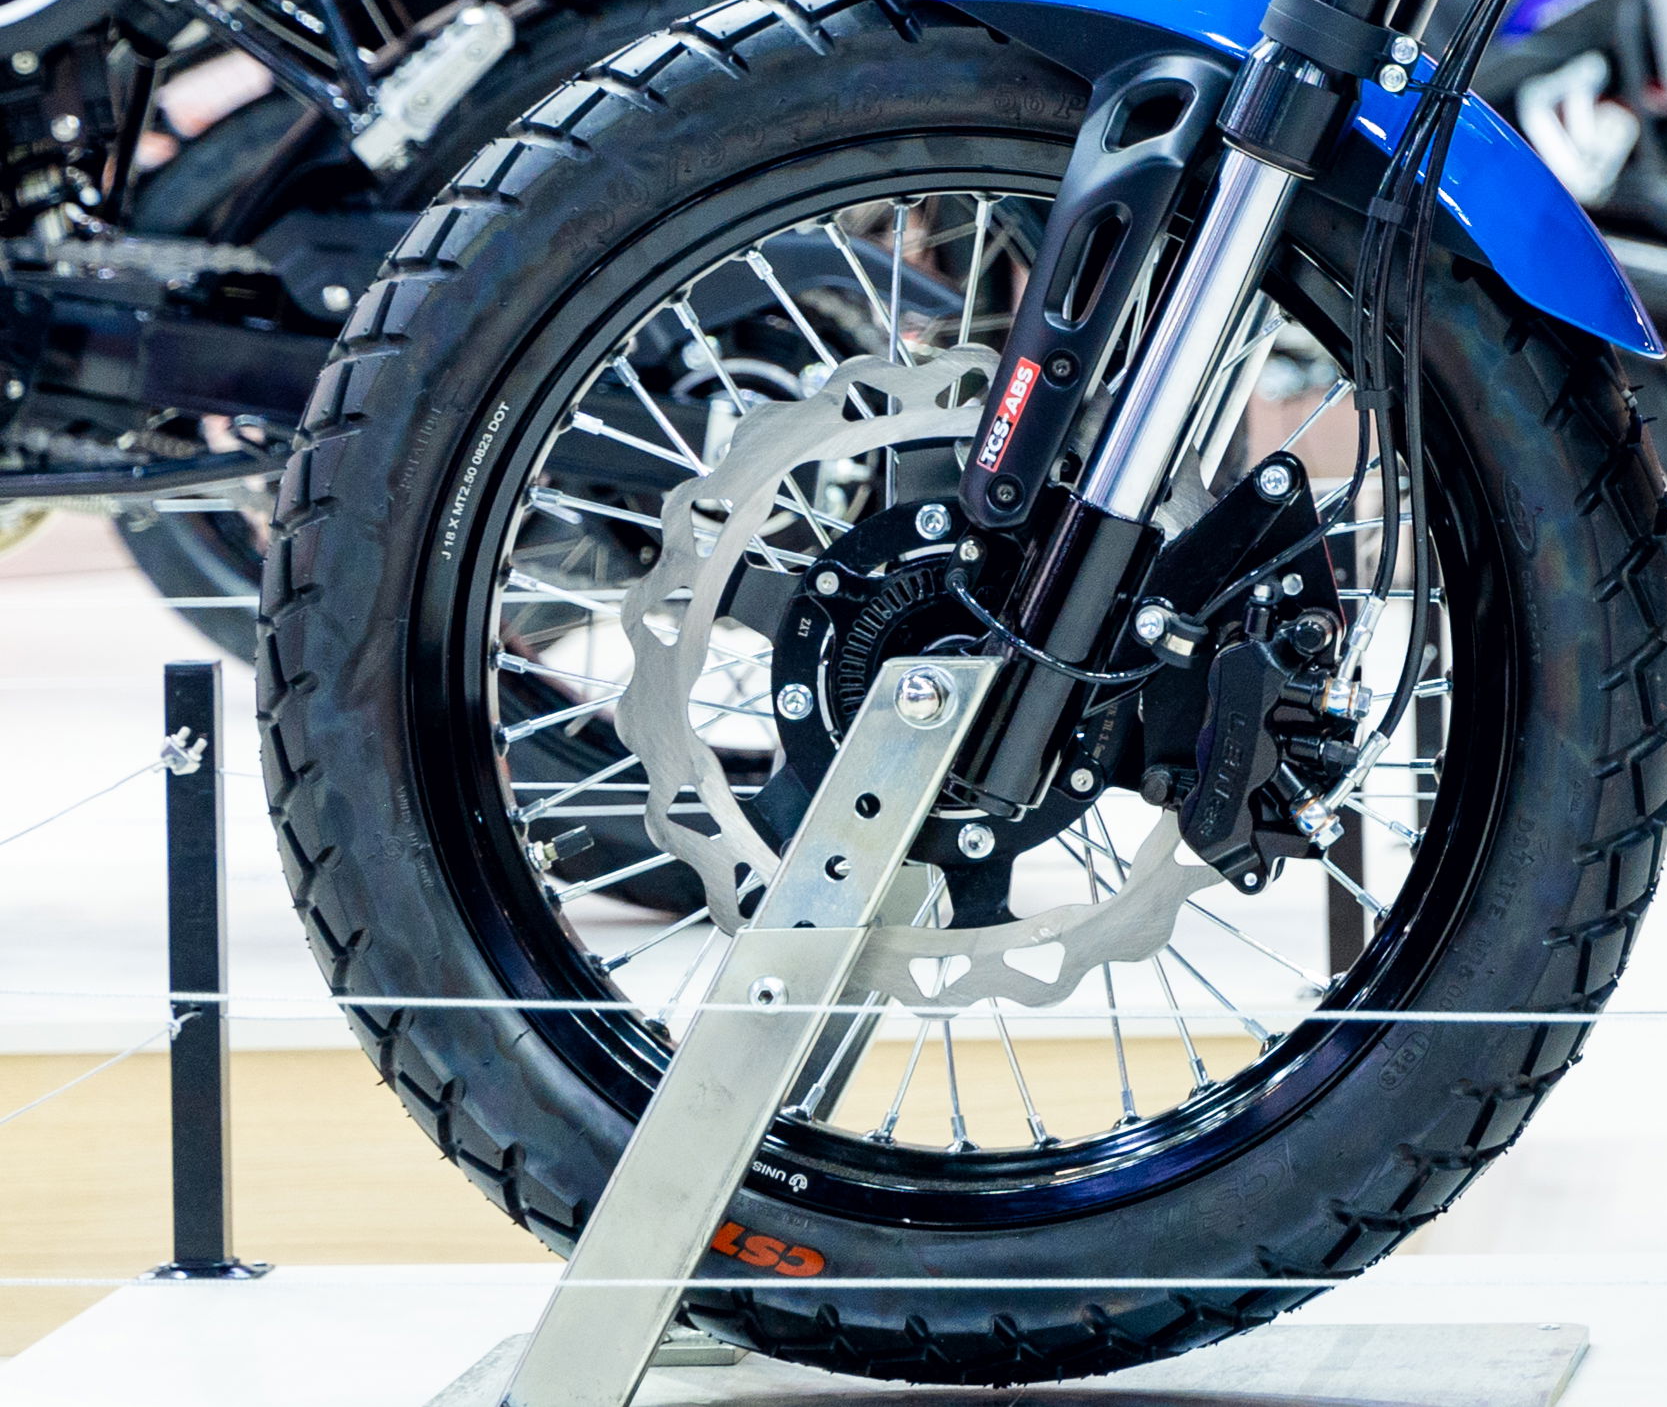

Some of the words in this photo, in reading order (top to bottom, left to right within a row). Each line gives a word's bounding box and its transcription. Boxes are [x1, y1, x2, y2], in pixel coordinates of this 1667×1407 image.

[487, 400, 511, 433] DOT
[471, 433, 494, 466] 0823
[452, 467, 478, 516] MT2.50
[447, 517, 460, 530] X
[443, 531, 457, 548] 18
[441, 550, 452, 561] J
